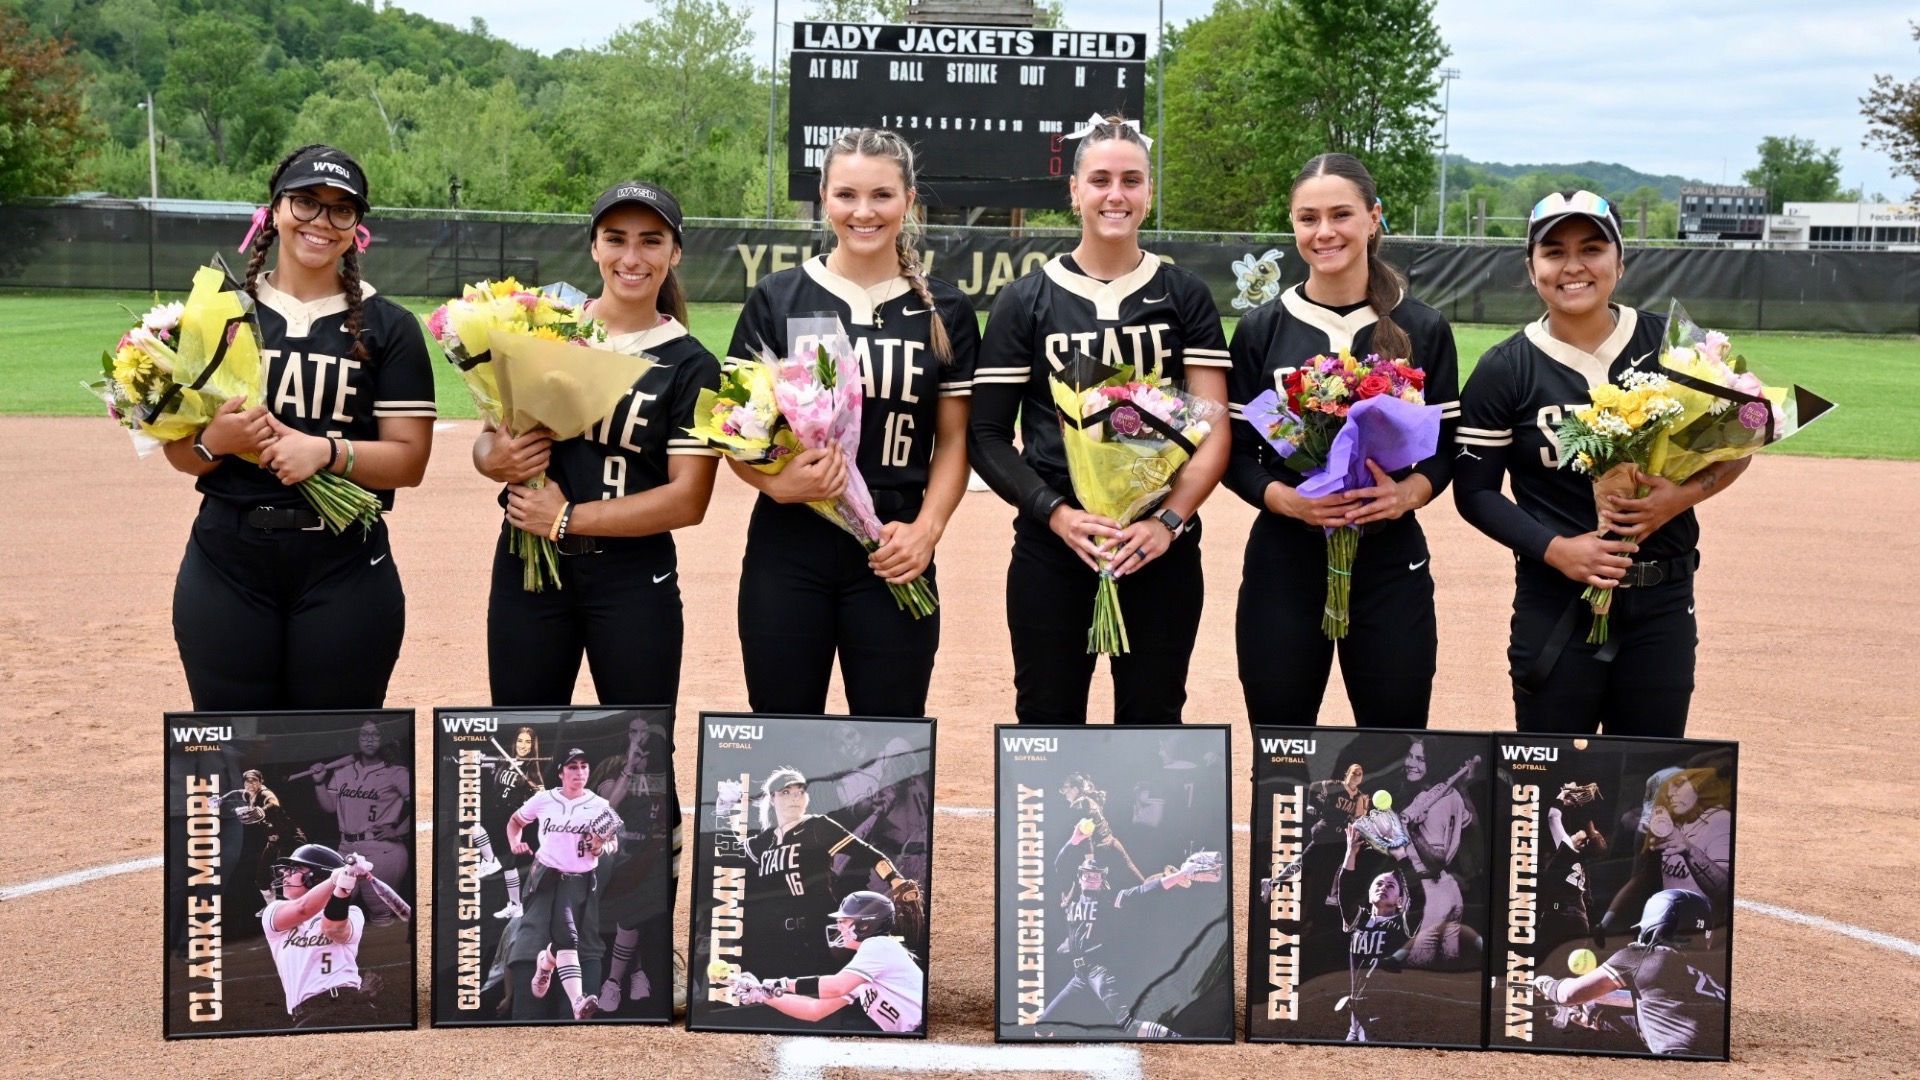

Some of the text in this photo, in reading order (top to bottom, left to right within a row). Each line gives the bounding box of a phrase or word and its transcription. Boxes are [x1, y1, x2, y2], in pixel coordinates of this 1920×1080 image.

[804, 25, 1135, 58] LADY JACKETS FIELD
[809, 58, 858, 79] AT BAT
[889, 61, 923, 82] BALL
[947, 62, 997, 84] STRIKE
[1020, 65, 1046, 86] OUT
[1075, 66, 1085, 87] H
[1117, 68, 1126, 88] E
[882, 115, 1022, 132] 1 2 3 4 5 6 7 8 9 10
[1039, 121, 1062, 133] RUNS
[1074, 122, 1089, 133] HIT
[804, 126, 872, 146] VISIT
[804, 148, 825, 168] HO
[313, 162, 350, 179] WVSU
[617, 187, 657, 200] WVSU
[260, 349, 361, 423] TATE
[882, 412, 915, 467] 16
[602, 456, 627, 500] 9
[172, 726, 232, 743] WVSU
[442, 717, 498, 734] WVSU
[708, 724, 763, 741] WVSU
[1003, 737, 1058, 754] WVSU
[1260, 738, 1316, 755] WVSU
[1501, 745, 1558, 762] WVSU
[1512, 763, 1547, 771] SOFTBALL
[336, 783, 380, 800] Jackets
[368, 806, 377, 822] 5
[758, 843, 801, 877] STATE
[785, 872, 804, 896] 16
[186, 774, 223, 1022] CLARKE MOORE
[1017, 784, 1044, 1026] KALEIGH MURPHY
[1505, 784, 1540, 1042] AVERY CONTRERAS
[1085, 922, 1093, 939] 7
[321, 953, 332, 975] 5
[458, 926, 481, 1011] GIANNA
[1268, 928, 1300, 1021] EMILY
